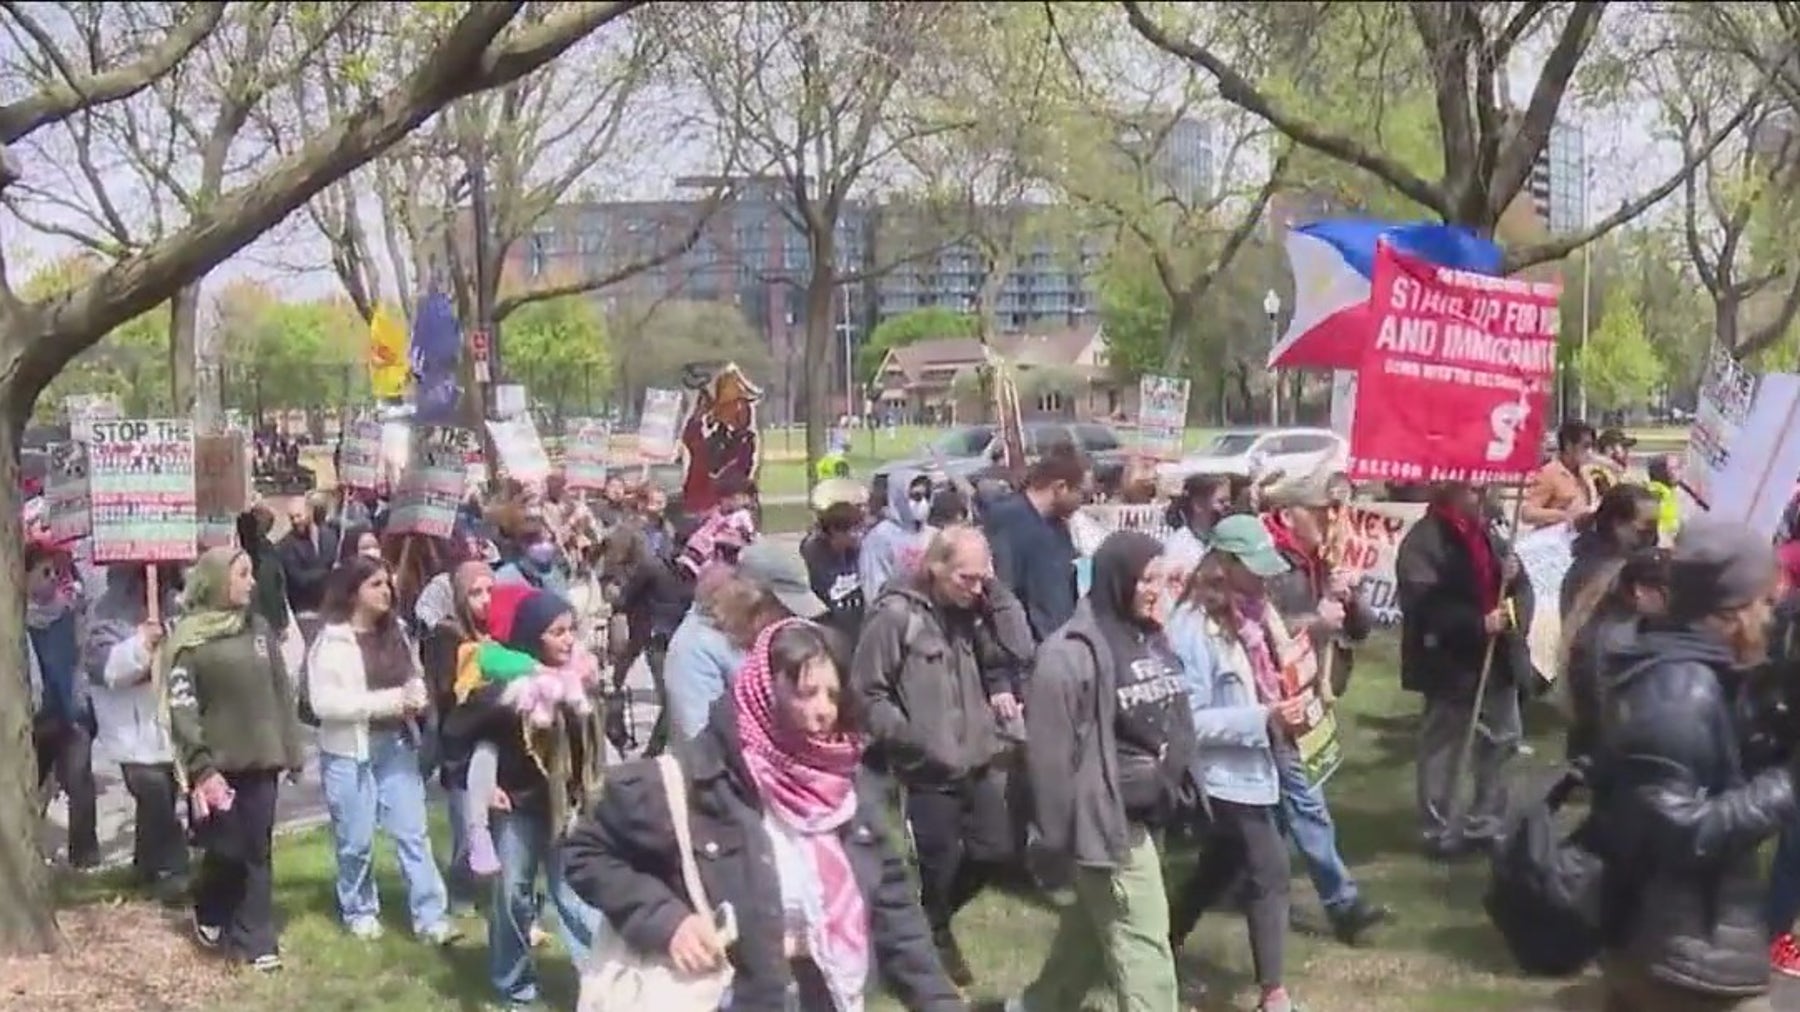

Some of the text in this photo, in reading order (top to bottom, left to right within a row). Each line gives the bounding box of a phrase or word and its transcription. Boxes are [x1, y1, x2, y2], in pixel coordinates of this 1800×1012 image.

[1503, 301, 1538, 334] FOR
[1376, 314, 1438, 356] AND
[93, 422, 192, 442] STOP THE
[1344, 540, 1379, 569] ND
